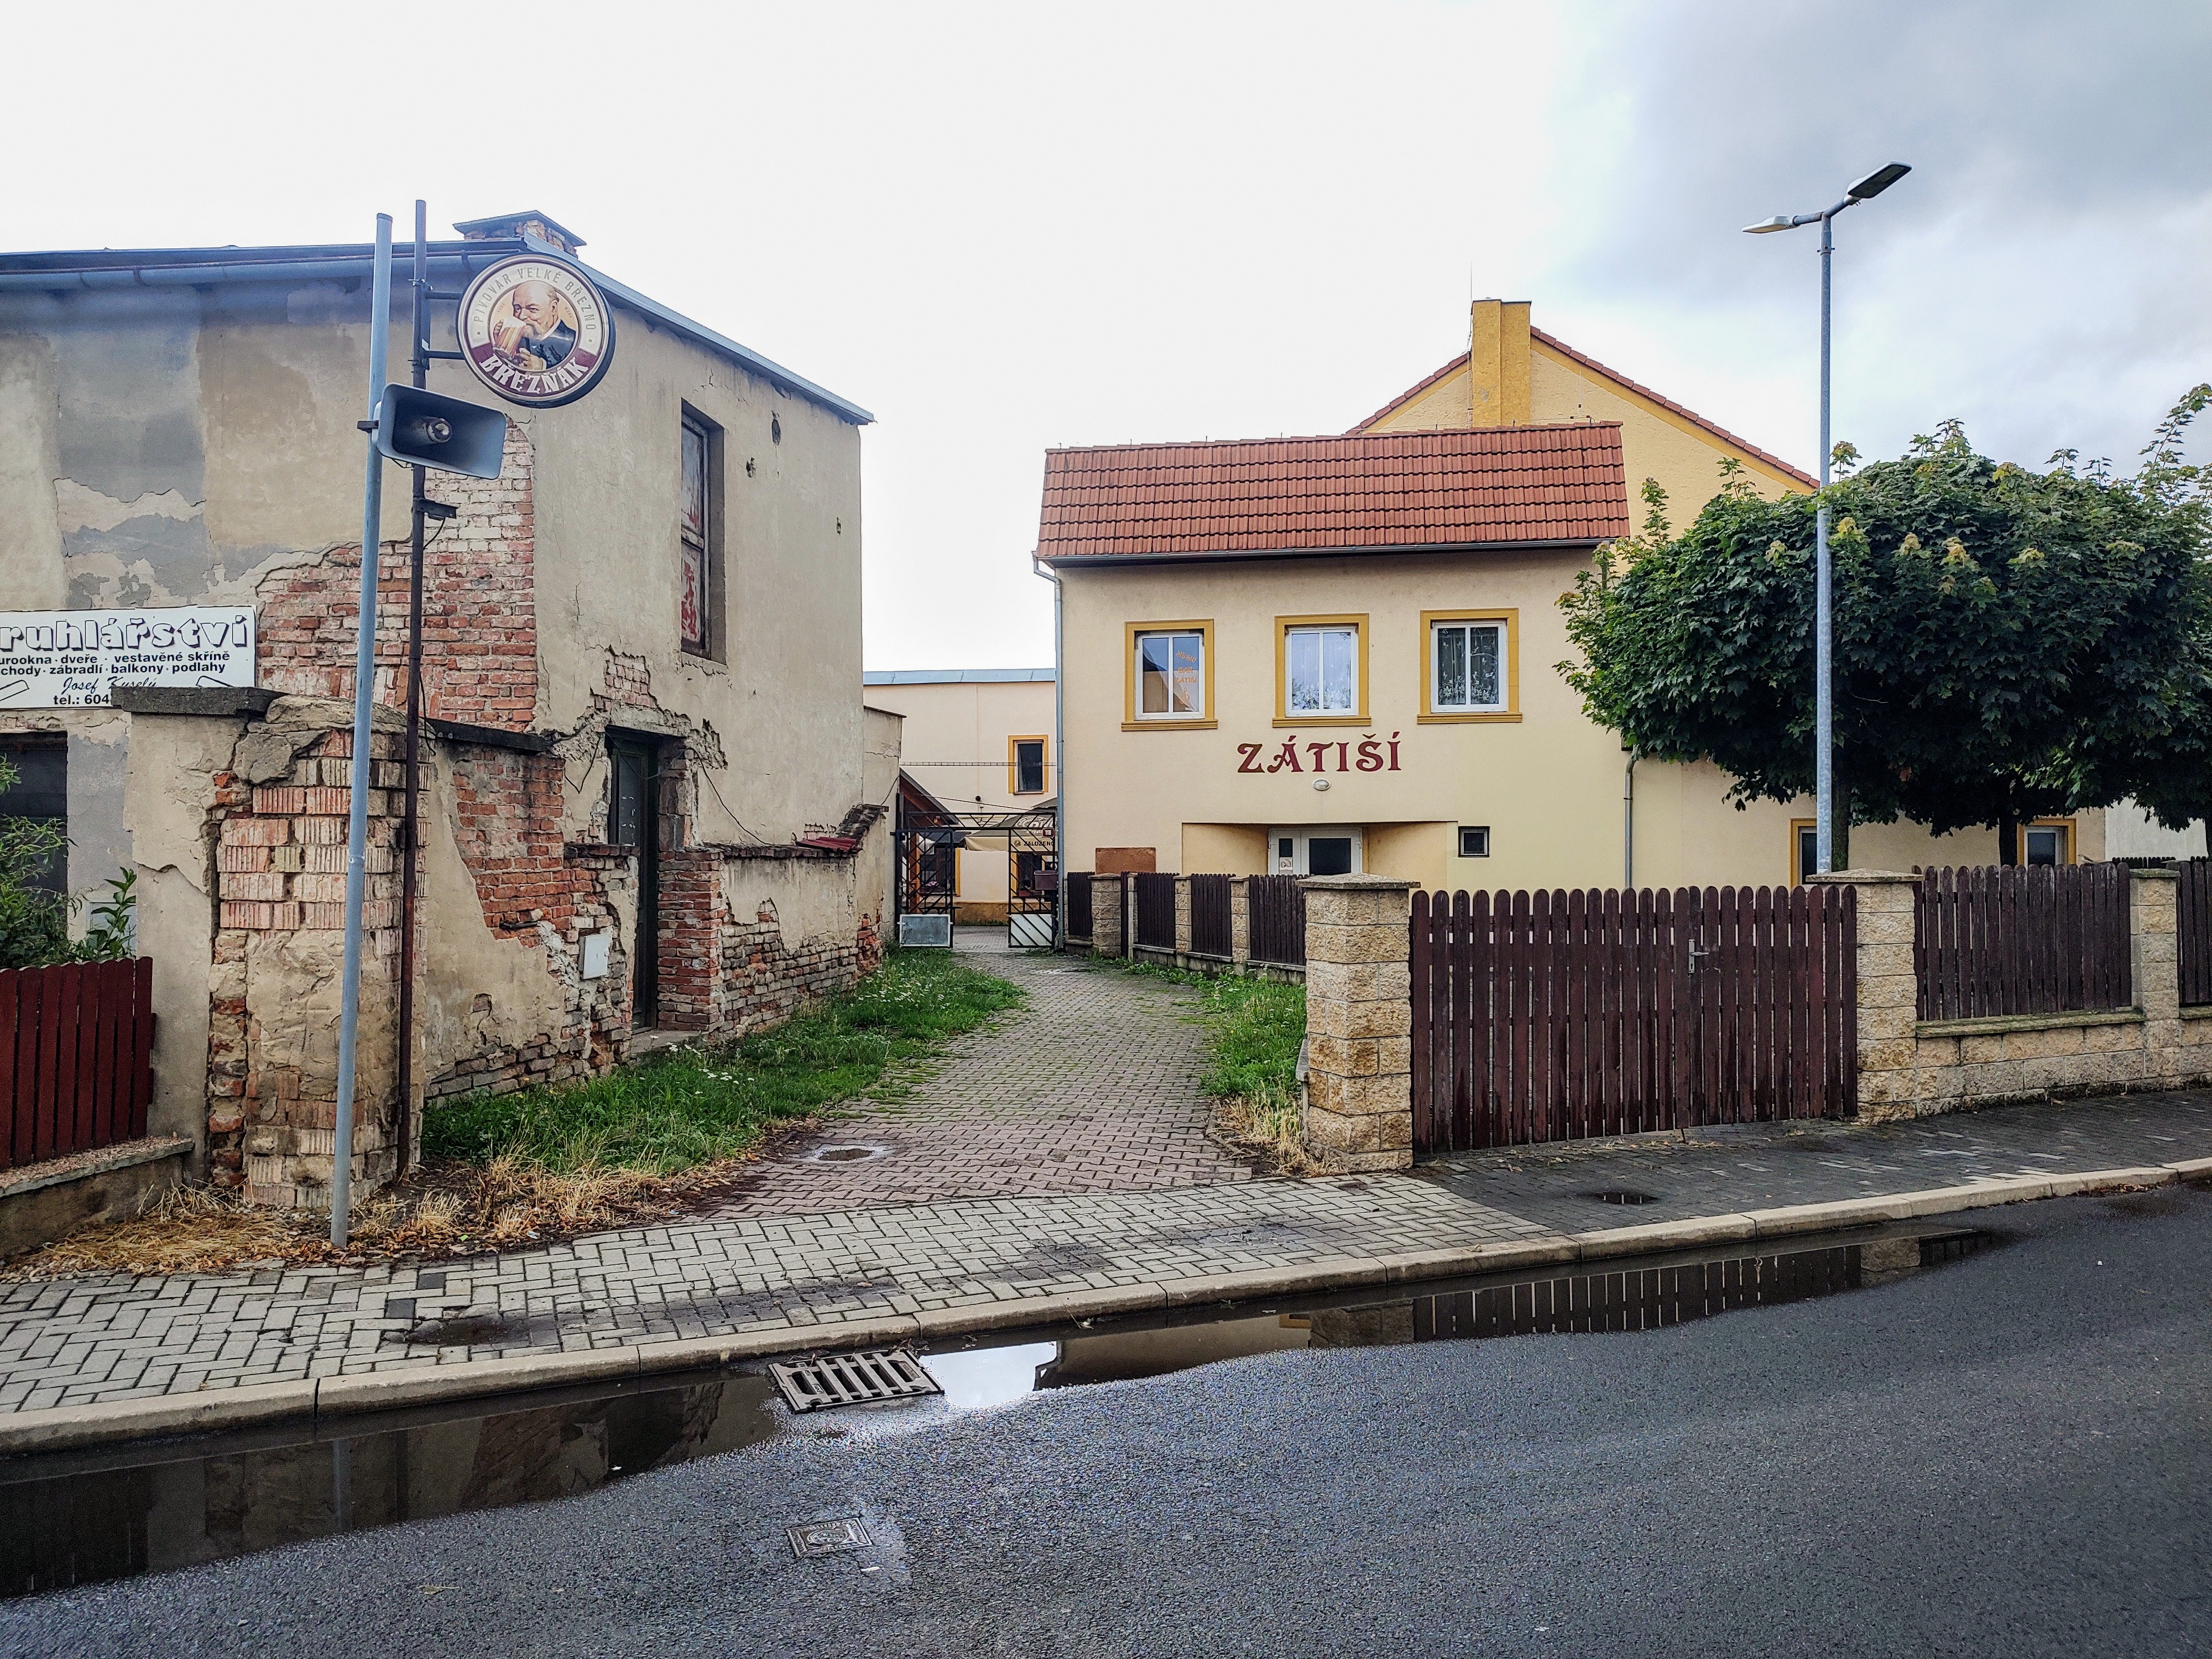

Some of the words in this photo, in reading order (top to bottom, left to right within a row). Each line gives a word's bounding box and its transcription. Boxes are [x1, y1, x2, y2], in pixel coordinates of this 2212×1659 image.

[473, 273, 512, 322] PIVOVAR
[517, 267, 562, 284] VELKÉ
[565, 281, 597, 331] BŘEZNO
[479, 354, 589, 394] BŘEZŇÁK
[61, 654, 97, 664] dveře
[114, 652, 183, 662] vestavěné
[188, 651, 230, 661] skříně
[1, 666, 41, 676] chody
[50, 664, 103, 674] zábradlí
[111, 664, 164, 674] balkony
[172, 662, 226, 674] podlahy
[61, 677, 98, 695] Josef
[54, 695, 80, 705] tel.:
[85, 695, 109, 705] 604
[1237, 731, 1402, 774] ZÁTIŠÍ
